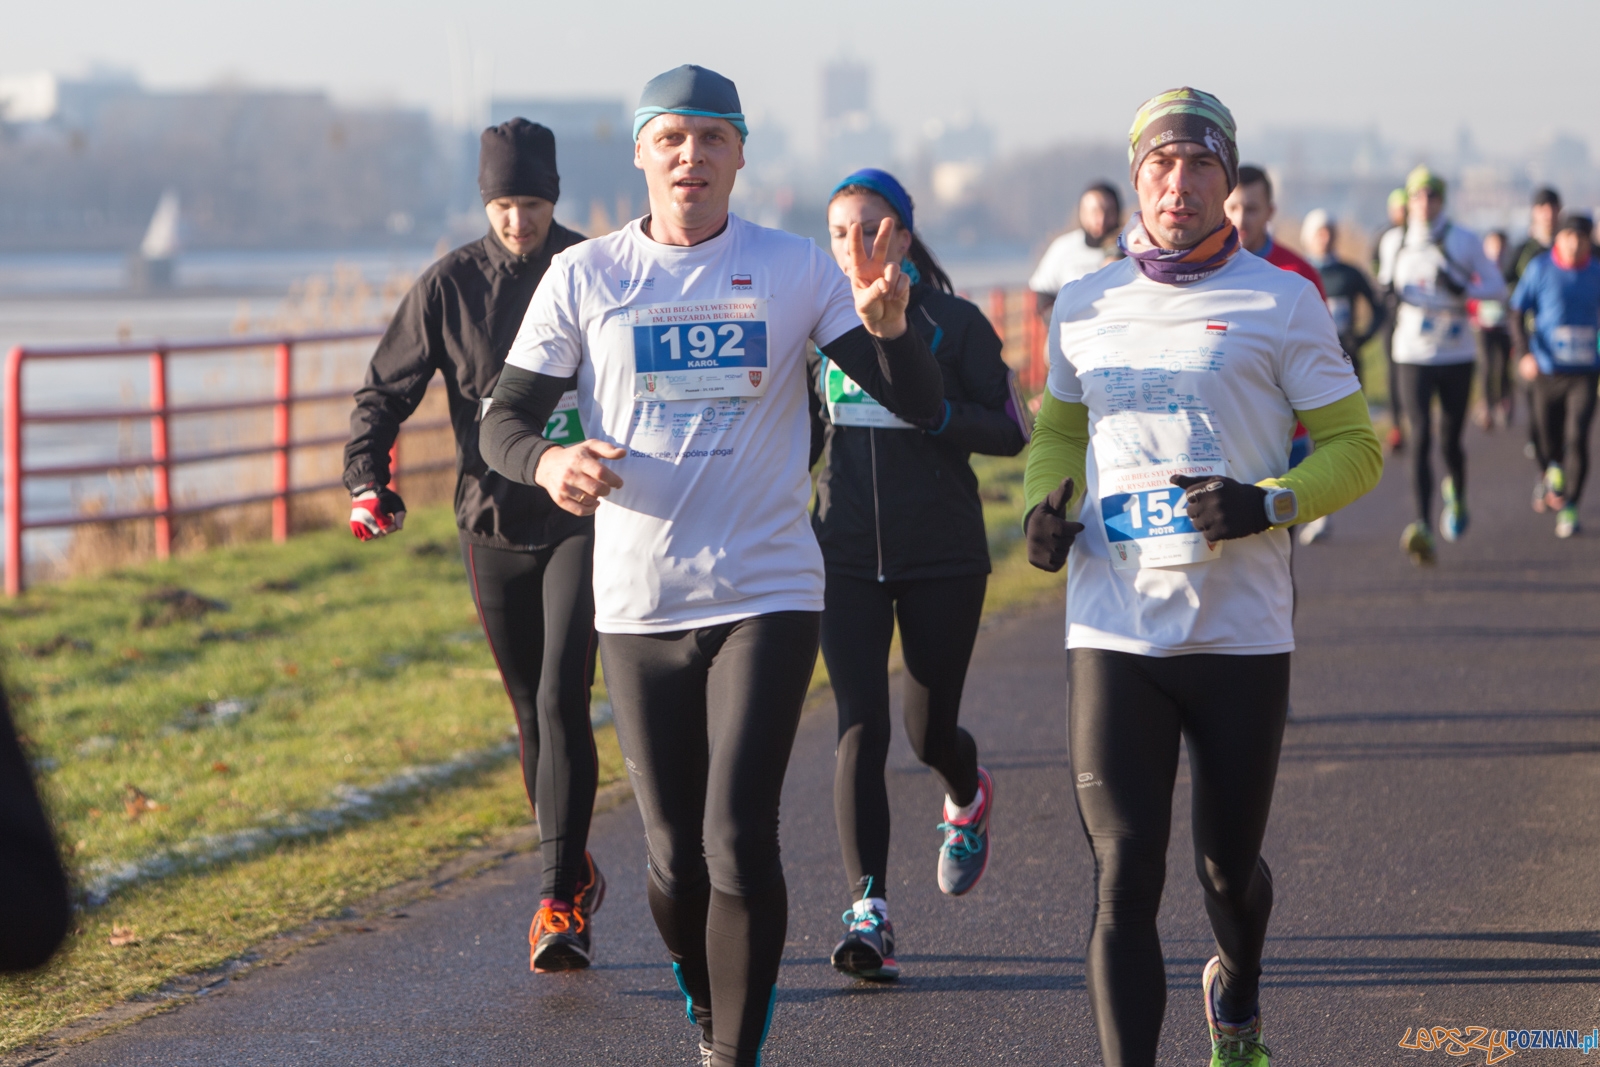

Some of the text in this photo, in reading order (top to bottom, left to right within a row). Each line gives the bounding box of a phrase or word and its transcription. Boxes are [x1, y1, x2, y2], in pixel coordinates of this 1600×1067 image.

[648, 303, 757, 315] XXXII BIEG SYLWESTROWY
[667, 313, 711, 323] RYSZARDA
[660, 324, 745, 359] 192
[687, 360, 719, 368] KAROL
[1131, 472, 1150, 480] BIEG
[1151, 465, 1214, 478] SYLWESTROWY
[1127, 480, 1167, 490] RYSZARDA
[1148, 526, 1175, 536] PIOTR
